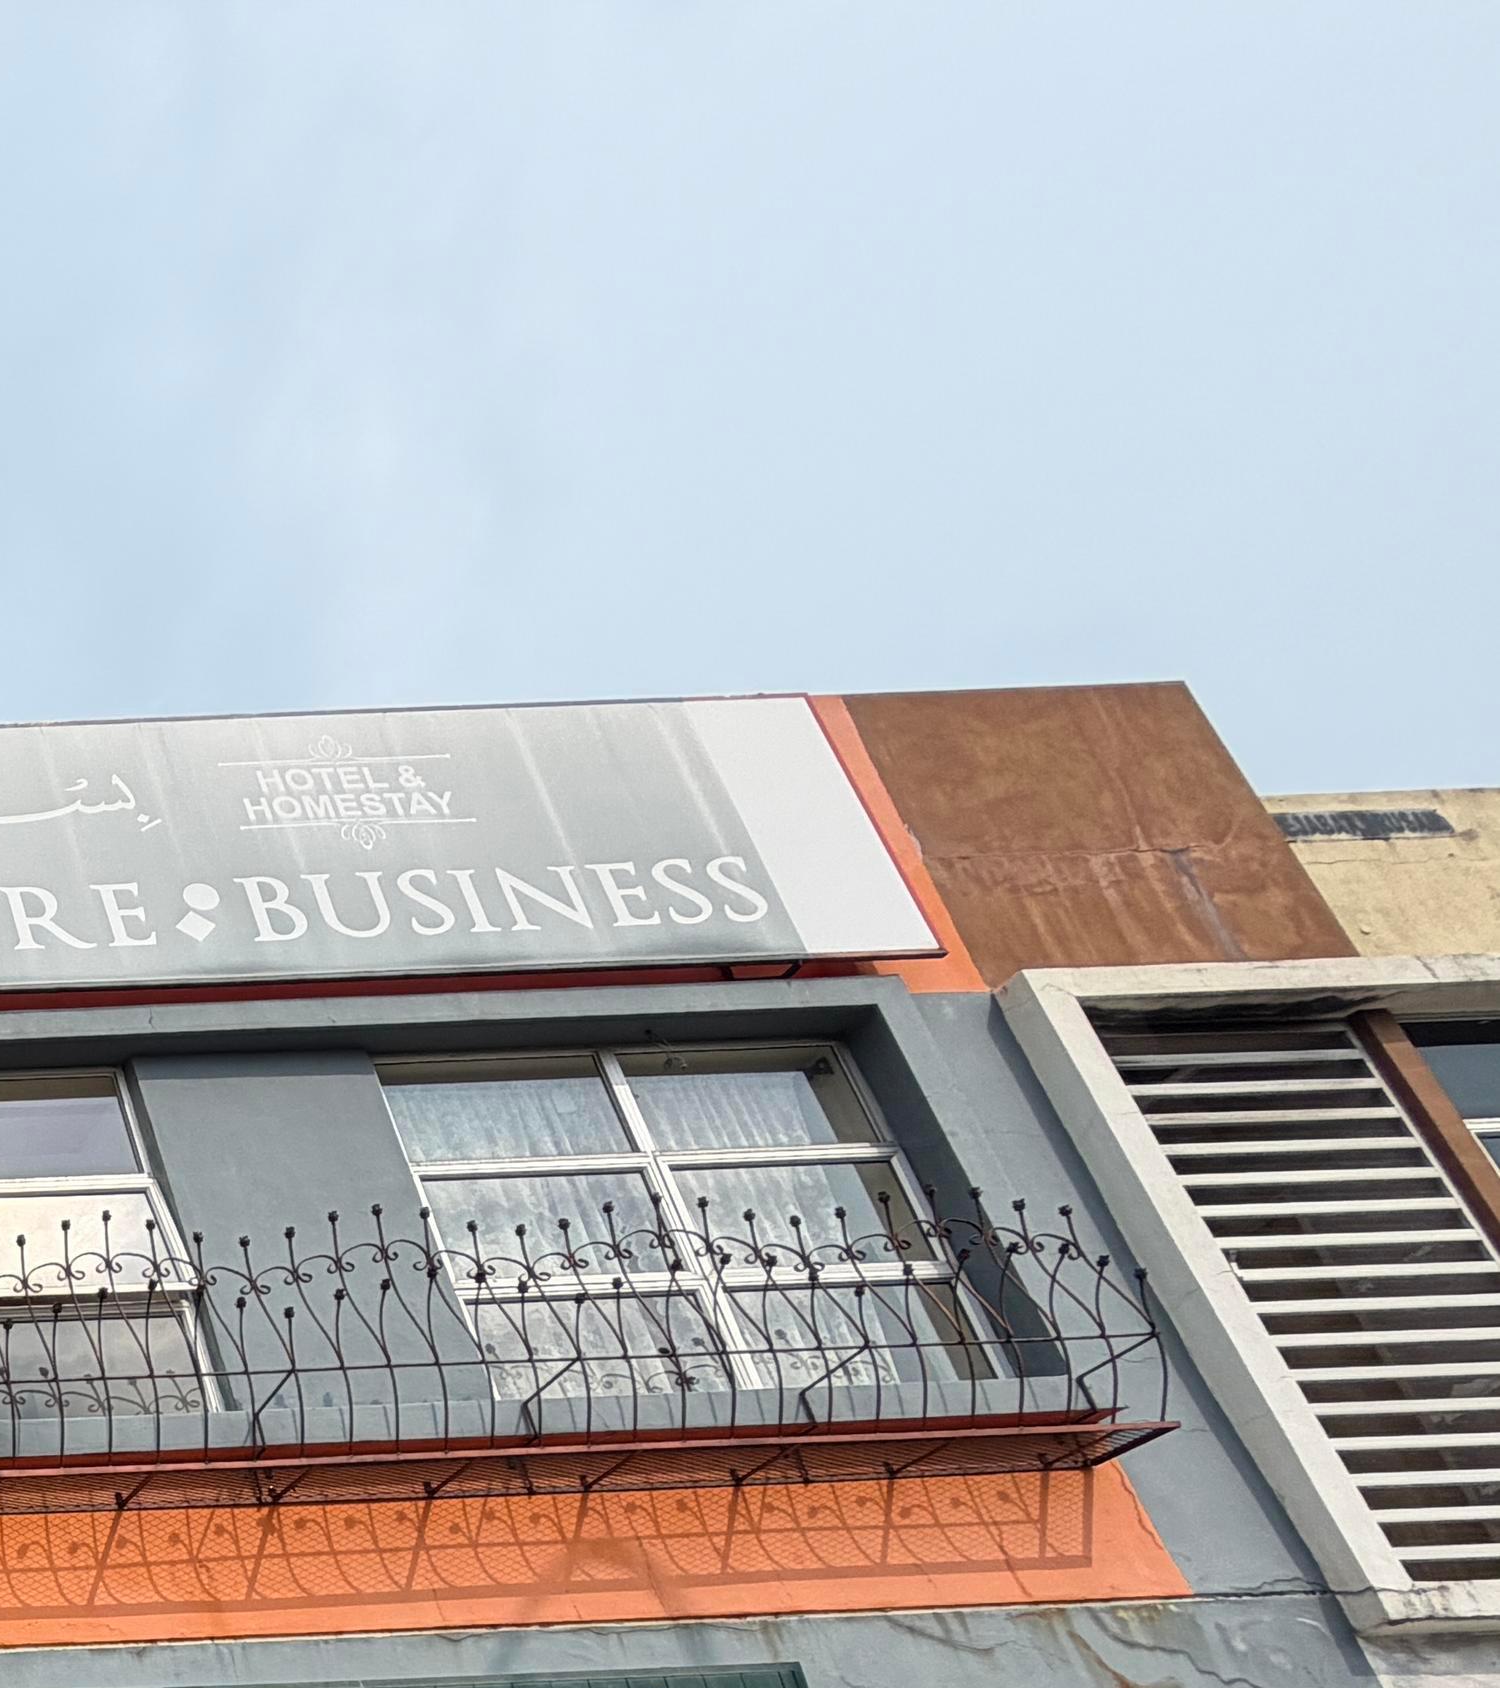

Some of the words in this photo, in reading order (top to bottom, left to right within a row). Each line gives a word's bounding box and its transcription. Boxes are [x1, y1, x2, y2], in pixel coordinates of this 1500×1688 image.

[254, 765, 388, 795] HOTEL
[397, 764, 427, 790] &
[241, 789, 454, 824] HOMESTAY
[231, 854, 771, 944] BUSINESS
